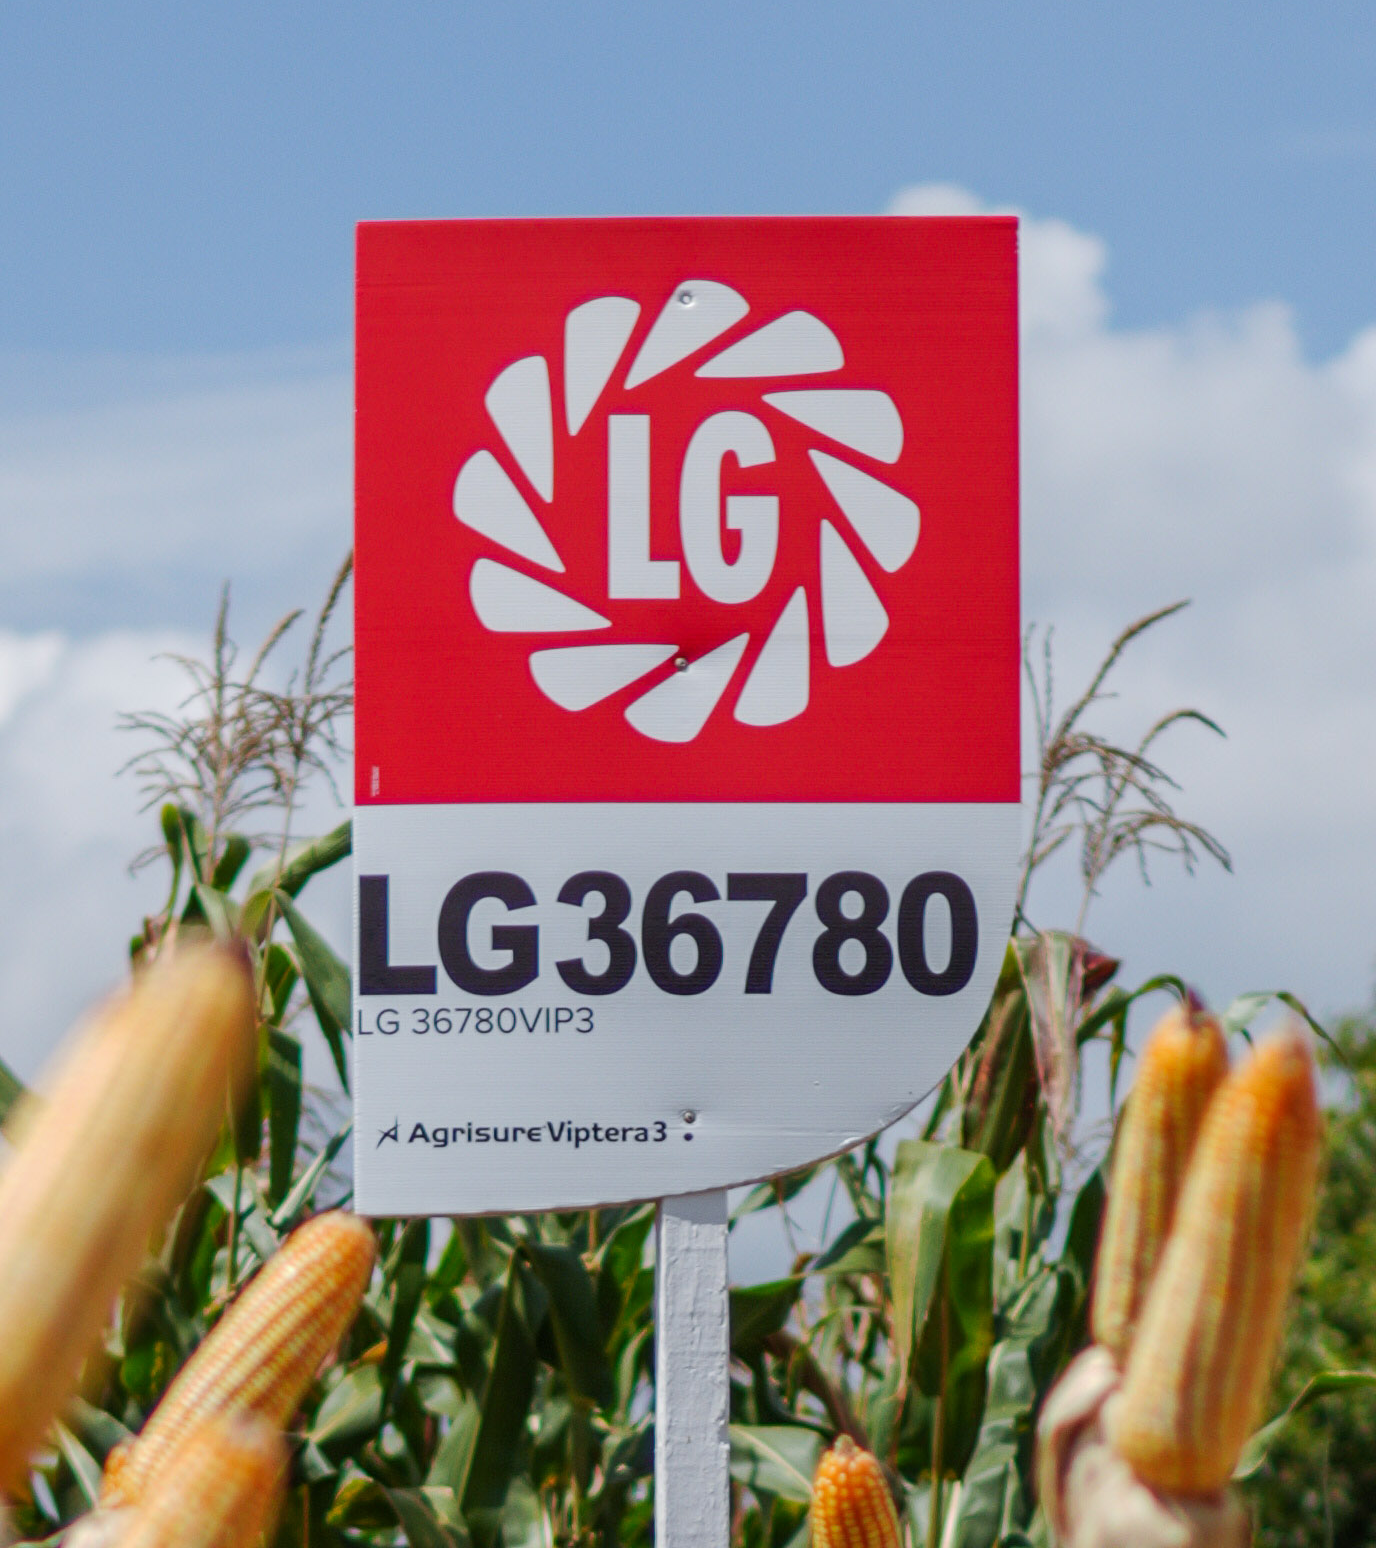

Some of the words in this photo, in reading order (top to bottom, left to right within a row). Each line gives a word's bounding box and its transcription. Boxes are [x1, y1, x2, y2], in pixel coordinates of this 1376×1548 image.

[607, 409, 780, 605] LG
[359, 869, 979, 997] LG36780
[358, 1008, 400, 1036] LG
[411, 1006, 595, 1036] 36780VIP3
[407, 1121, 544, 1149] Agrisure
